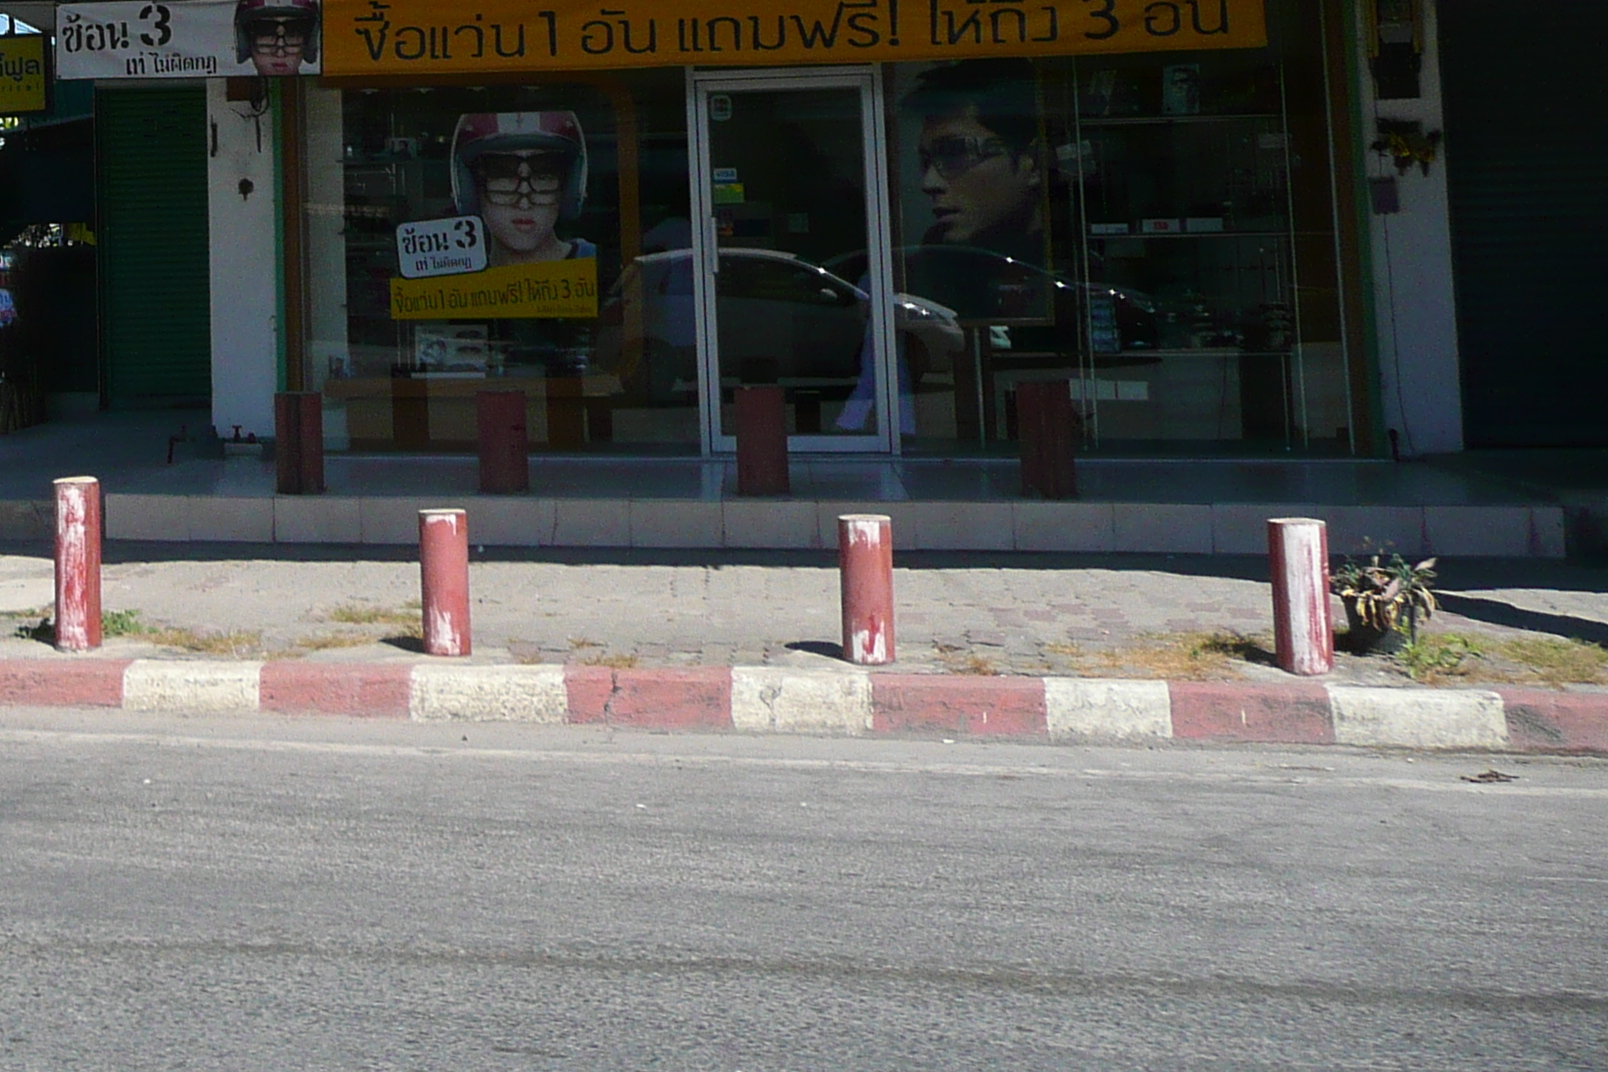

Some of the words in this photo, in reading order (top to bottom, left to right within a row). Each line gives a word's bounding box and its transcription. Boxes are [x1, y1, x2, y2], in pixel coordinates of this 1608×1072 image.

[139, 4, 172, 46] 3
[354, 1, 525, 61] ซื้อแว่น
[539, 11, 557, 58] 1
[581, 9, 657, 55] อัน
[454, 220, 477, 249] 3
[561, 279, 571, 299] 3
